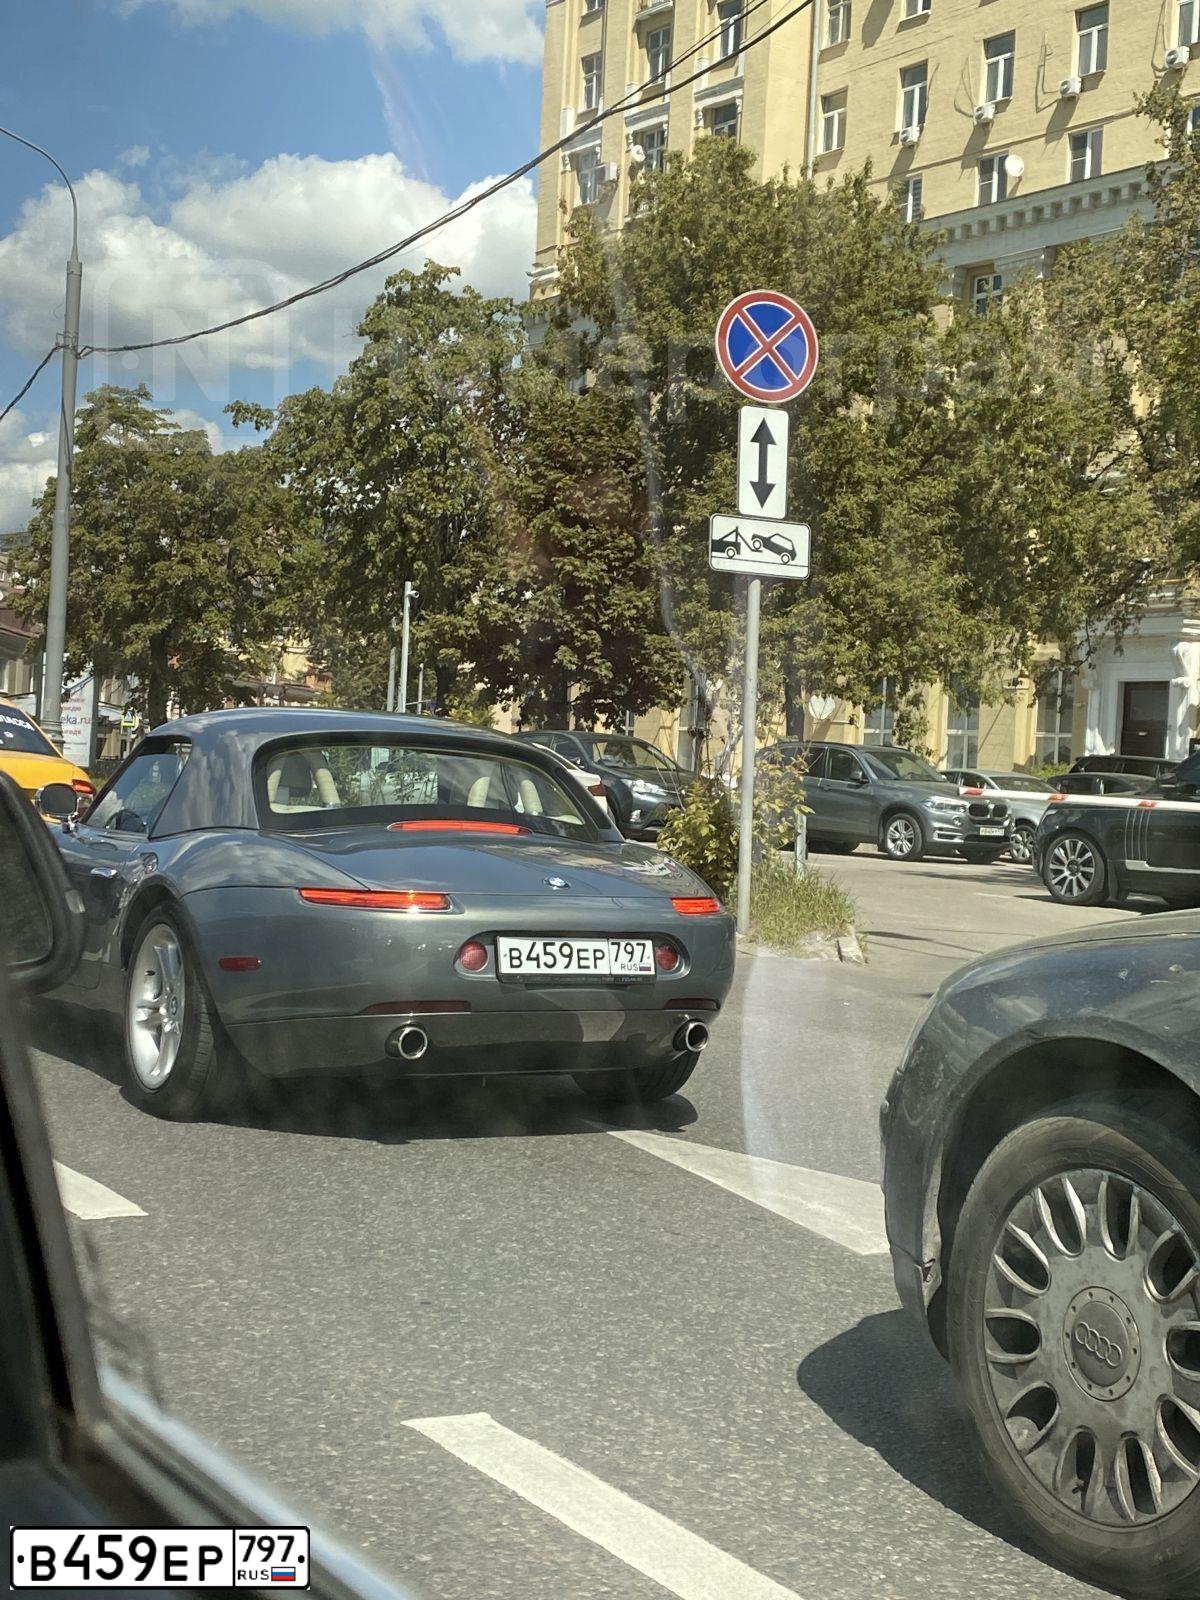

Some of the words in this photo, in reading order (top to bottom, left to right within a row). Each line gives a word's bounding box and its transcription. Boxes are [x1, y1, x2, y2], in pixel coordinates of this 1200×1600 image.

[508, 941, 606, 970] В459ЕР
[610, 942, 647, 963] 797
[620, 963, 639, 972] RUS
